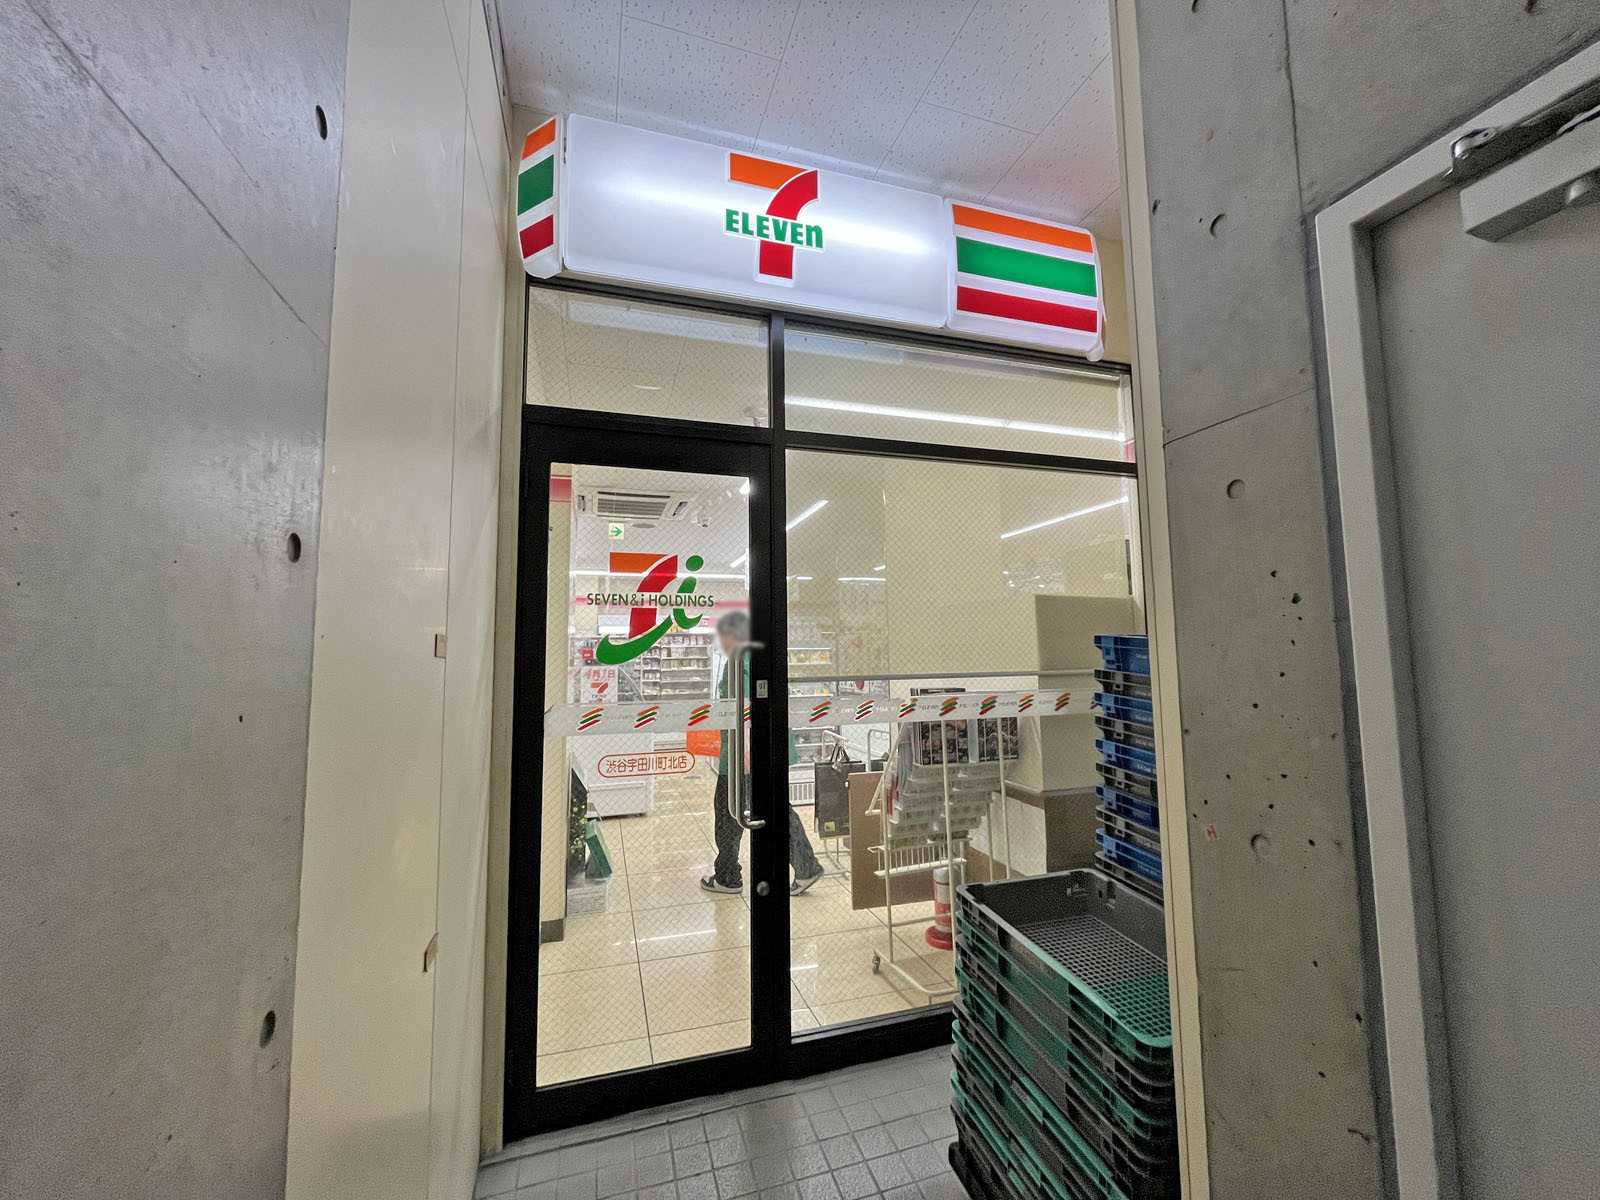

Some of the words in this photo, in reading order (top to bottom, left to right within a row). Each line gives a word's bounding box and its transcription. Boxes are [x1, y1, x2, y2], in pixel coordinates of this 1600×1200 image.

[648, 594, 715, 608] HOLDINGS
[606, 756, 688, 774] 渋谷宇田川町北店
